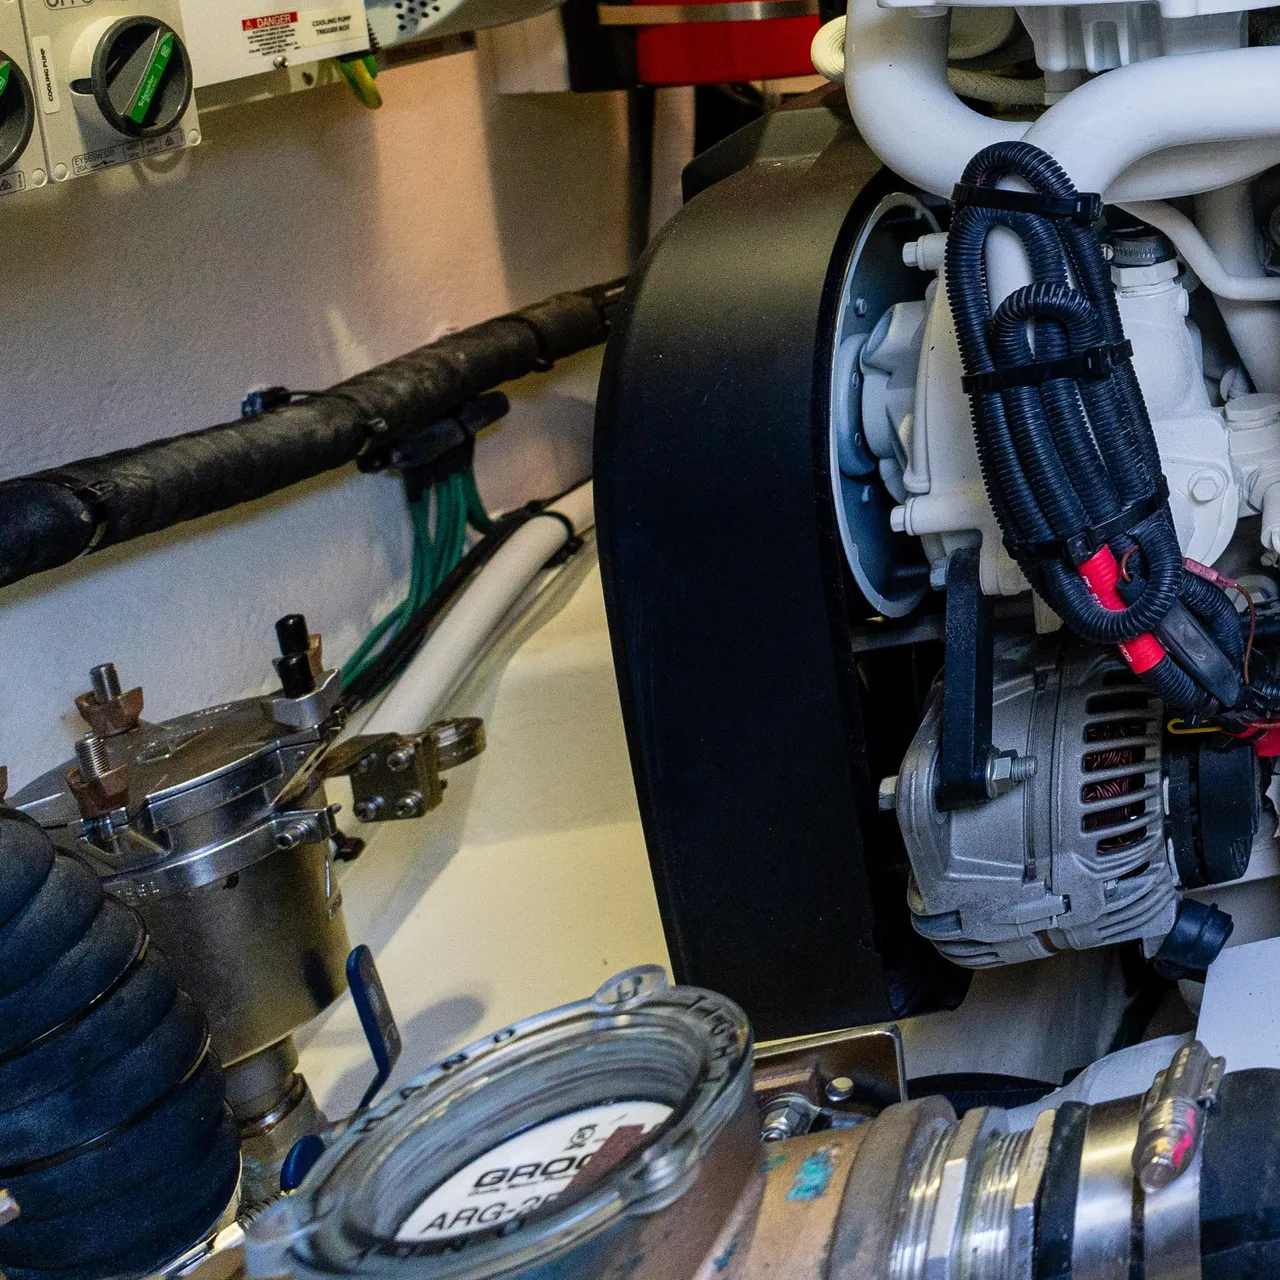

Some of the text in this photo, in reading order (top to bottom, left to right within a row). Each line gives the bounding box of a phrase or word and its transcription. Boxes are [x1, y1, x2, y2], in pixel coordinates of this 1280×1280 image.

[256, 14, 292, 28] DANGER
[312, 15, 352, 27] COOLING PUMP
[316, 26, 339, 36] TRIGGER
[40, 48, 54, 102] COOLING PUMP
